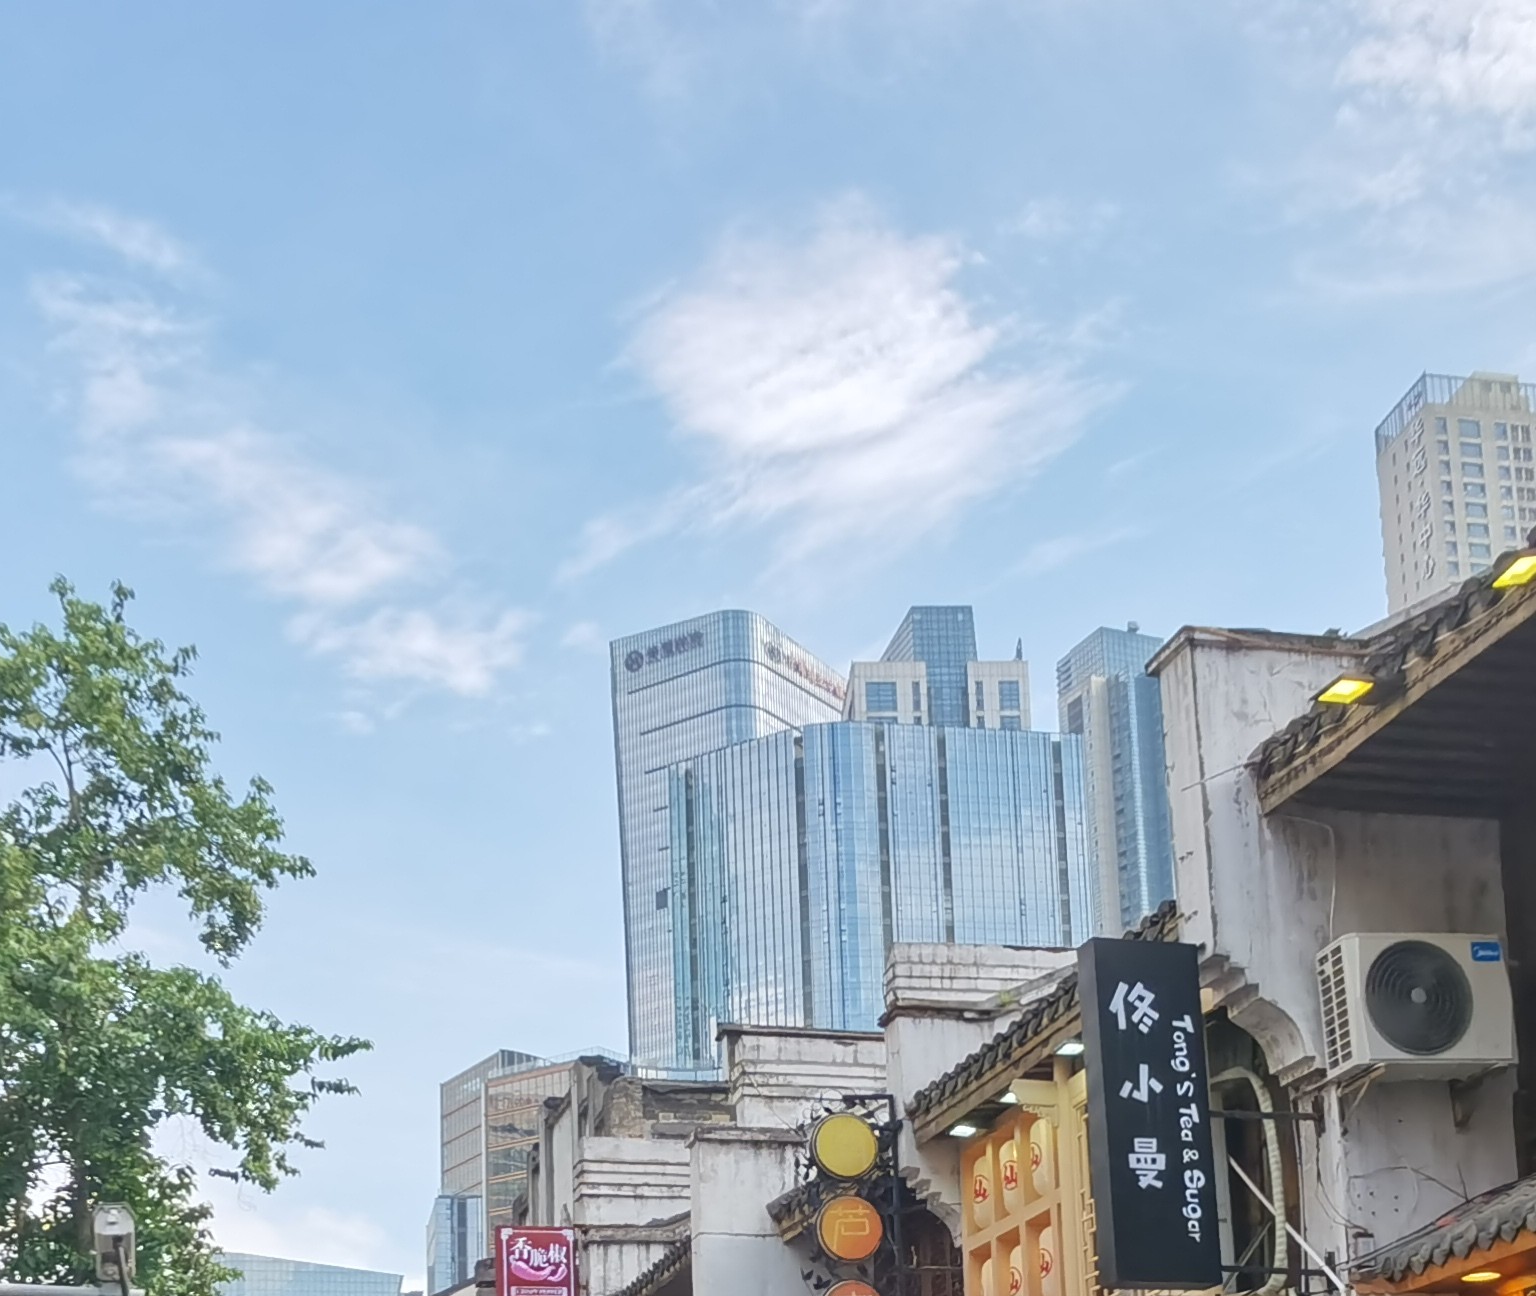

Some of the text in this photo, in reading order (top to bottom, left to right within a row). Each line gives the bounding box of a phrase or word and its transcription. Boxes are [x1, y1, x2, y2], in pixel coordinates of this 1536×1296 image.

[1109, 981, 1166, 1189] 佟小曼
[1178, 1106, 1200, 1142] Tea
[1181, 1149, 1199, 1164] &
[1181, 1168, 1206, 1244] Sugar
